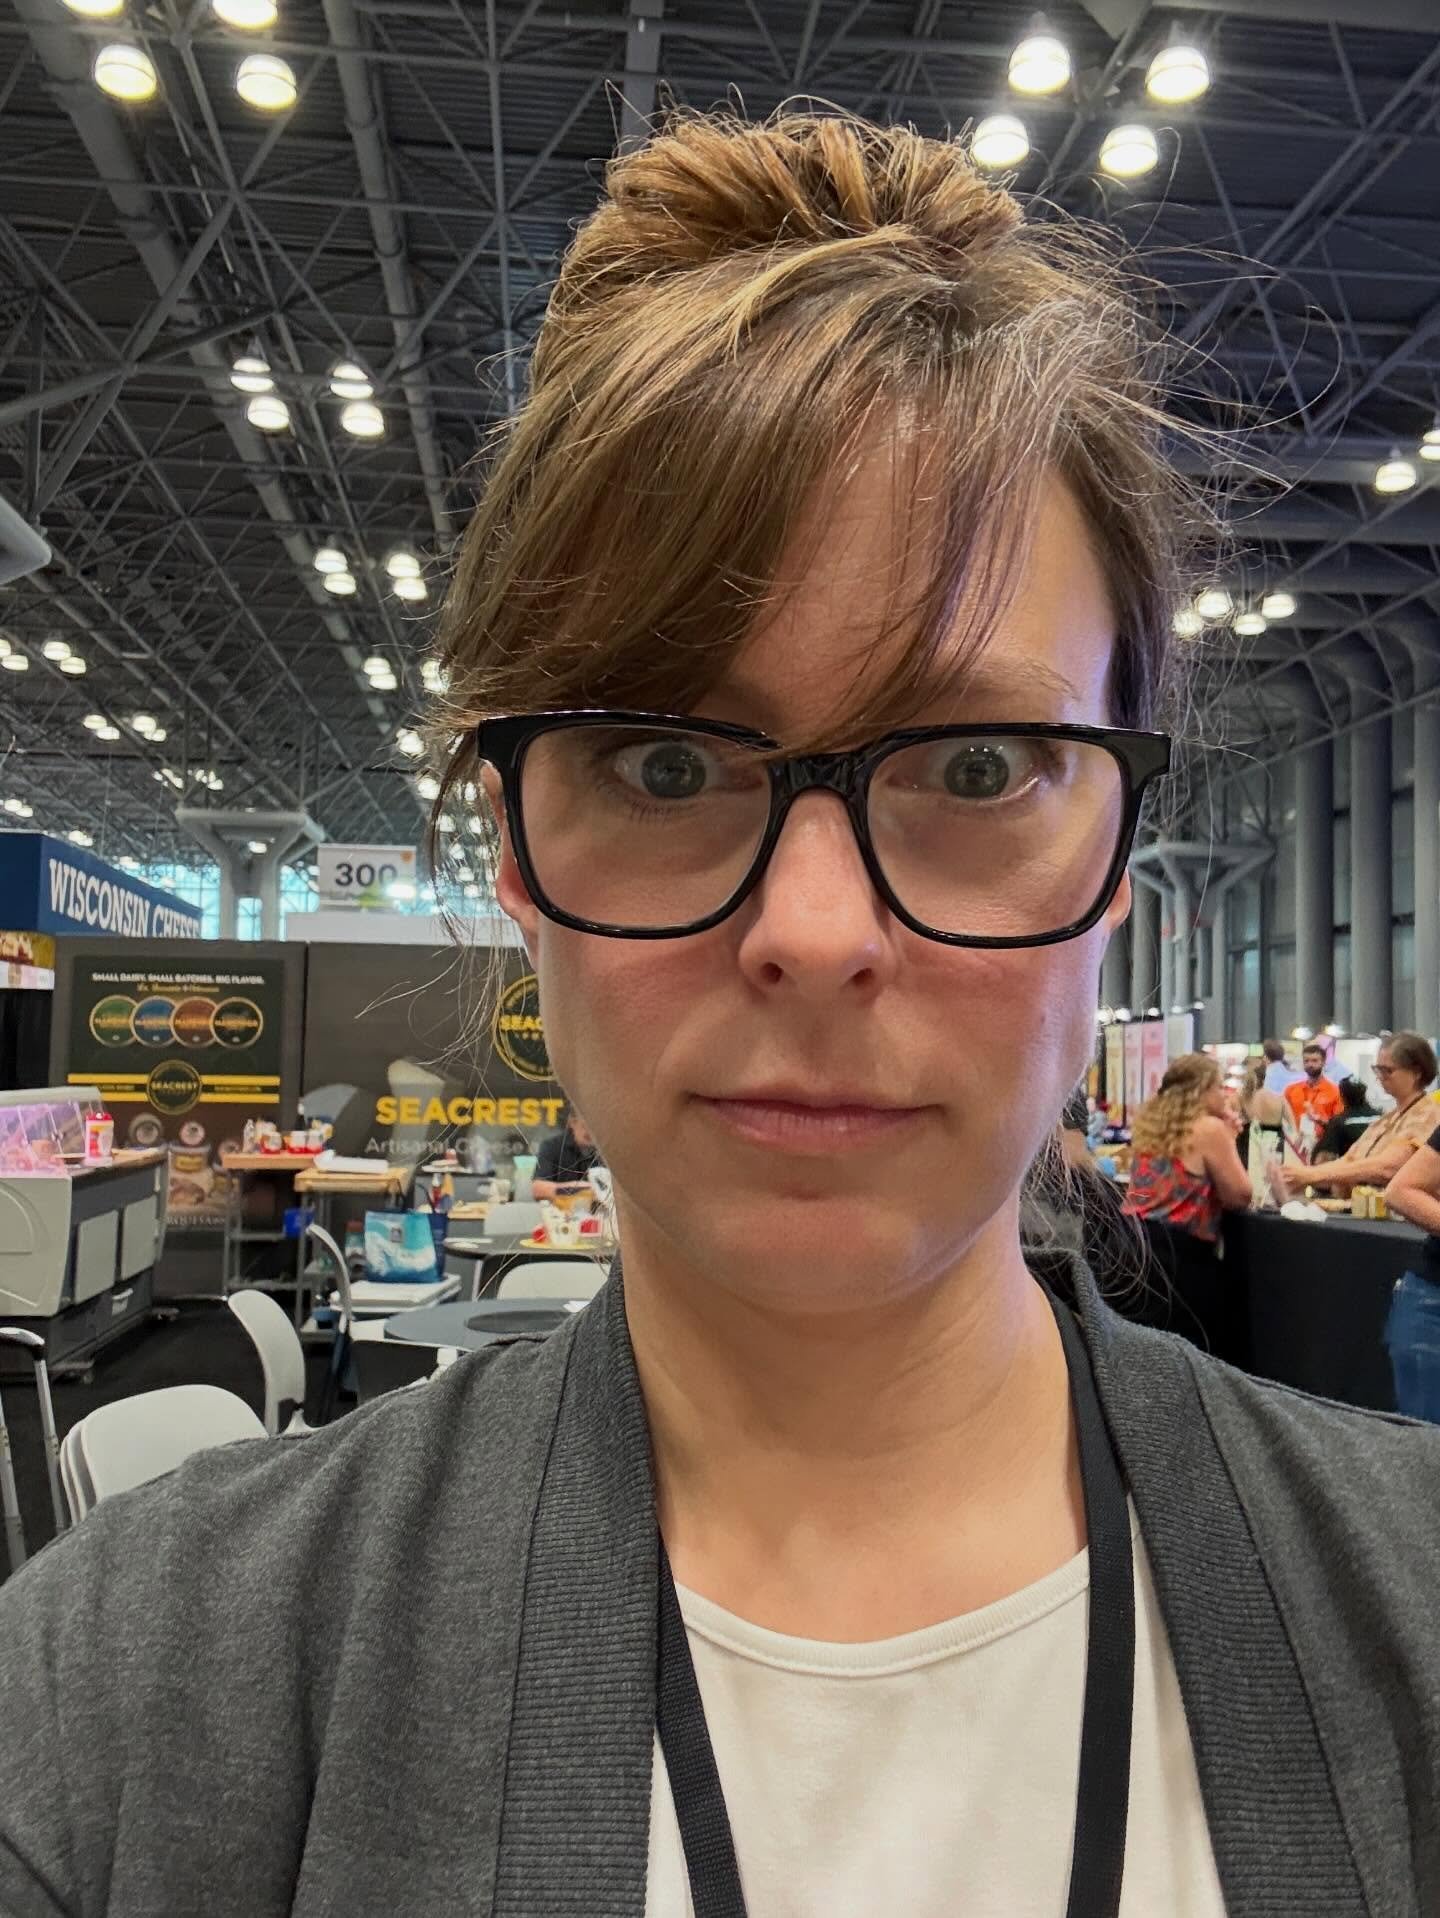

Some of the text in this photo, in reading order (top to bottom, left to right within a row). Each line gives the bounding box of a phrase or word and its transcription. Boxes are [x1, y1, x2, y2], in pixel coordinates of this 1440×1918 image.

[335, 862, 397, 888] 300
[49, 857, 151, 939] WISCONSIN
[500, 1014, 544, 1031] SEAC
[151, 1081, 198, 1090] SEACREST
[376, 1096, 563, 1126] SEACREST
[455, 1137, 524, 1155] Cese
